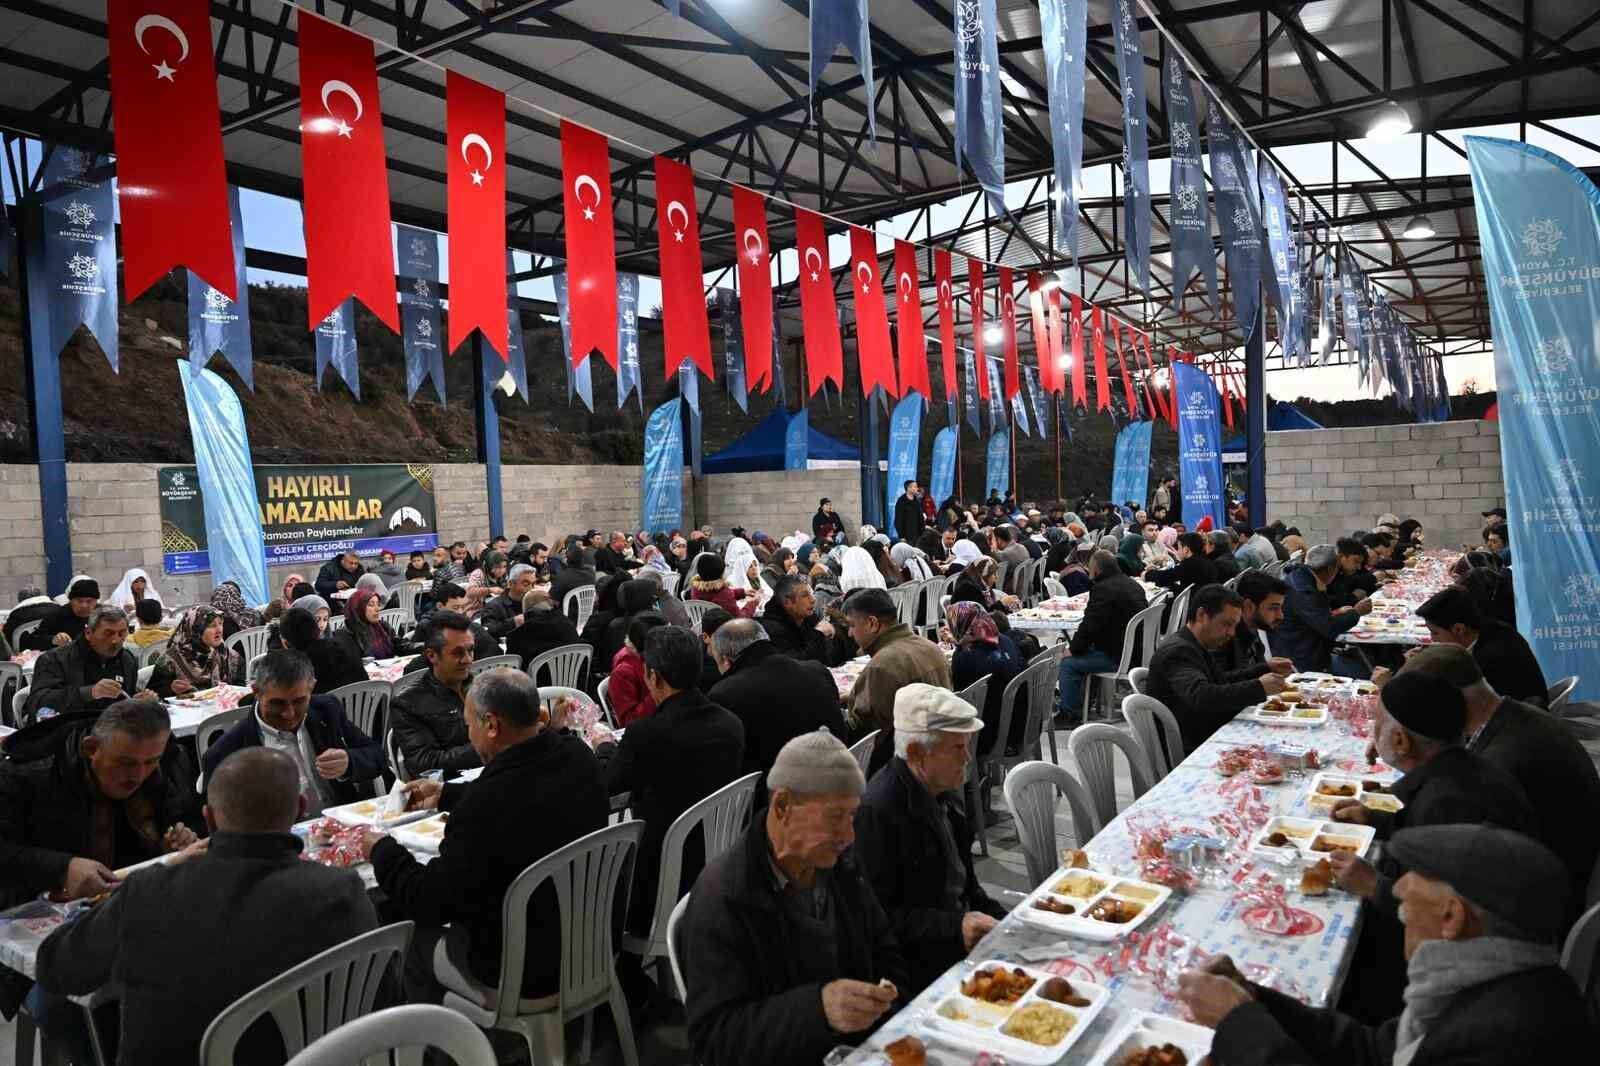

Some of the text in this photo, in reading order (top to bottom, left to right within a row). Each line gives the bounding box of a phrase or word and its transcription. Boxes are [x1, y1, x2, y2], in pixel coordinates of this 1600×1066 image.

[267, 475, 351, 498] HAYIRLI
[257, 498, 383, 525] AMAZANLAR
[306, 526, 364, 540] Paylaşmaktır
[273, 541, 354, 555] ÖZLEM ÇERÇİOĞLU
